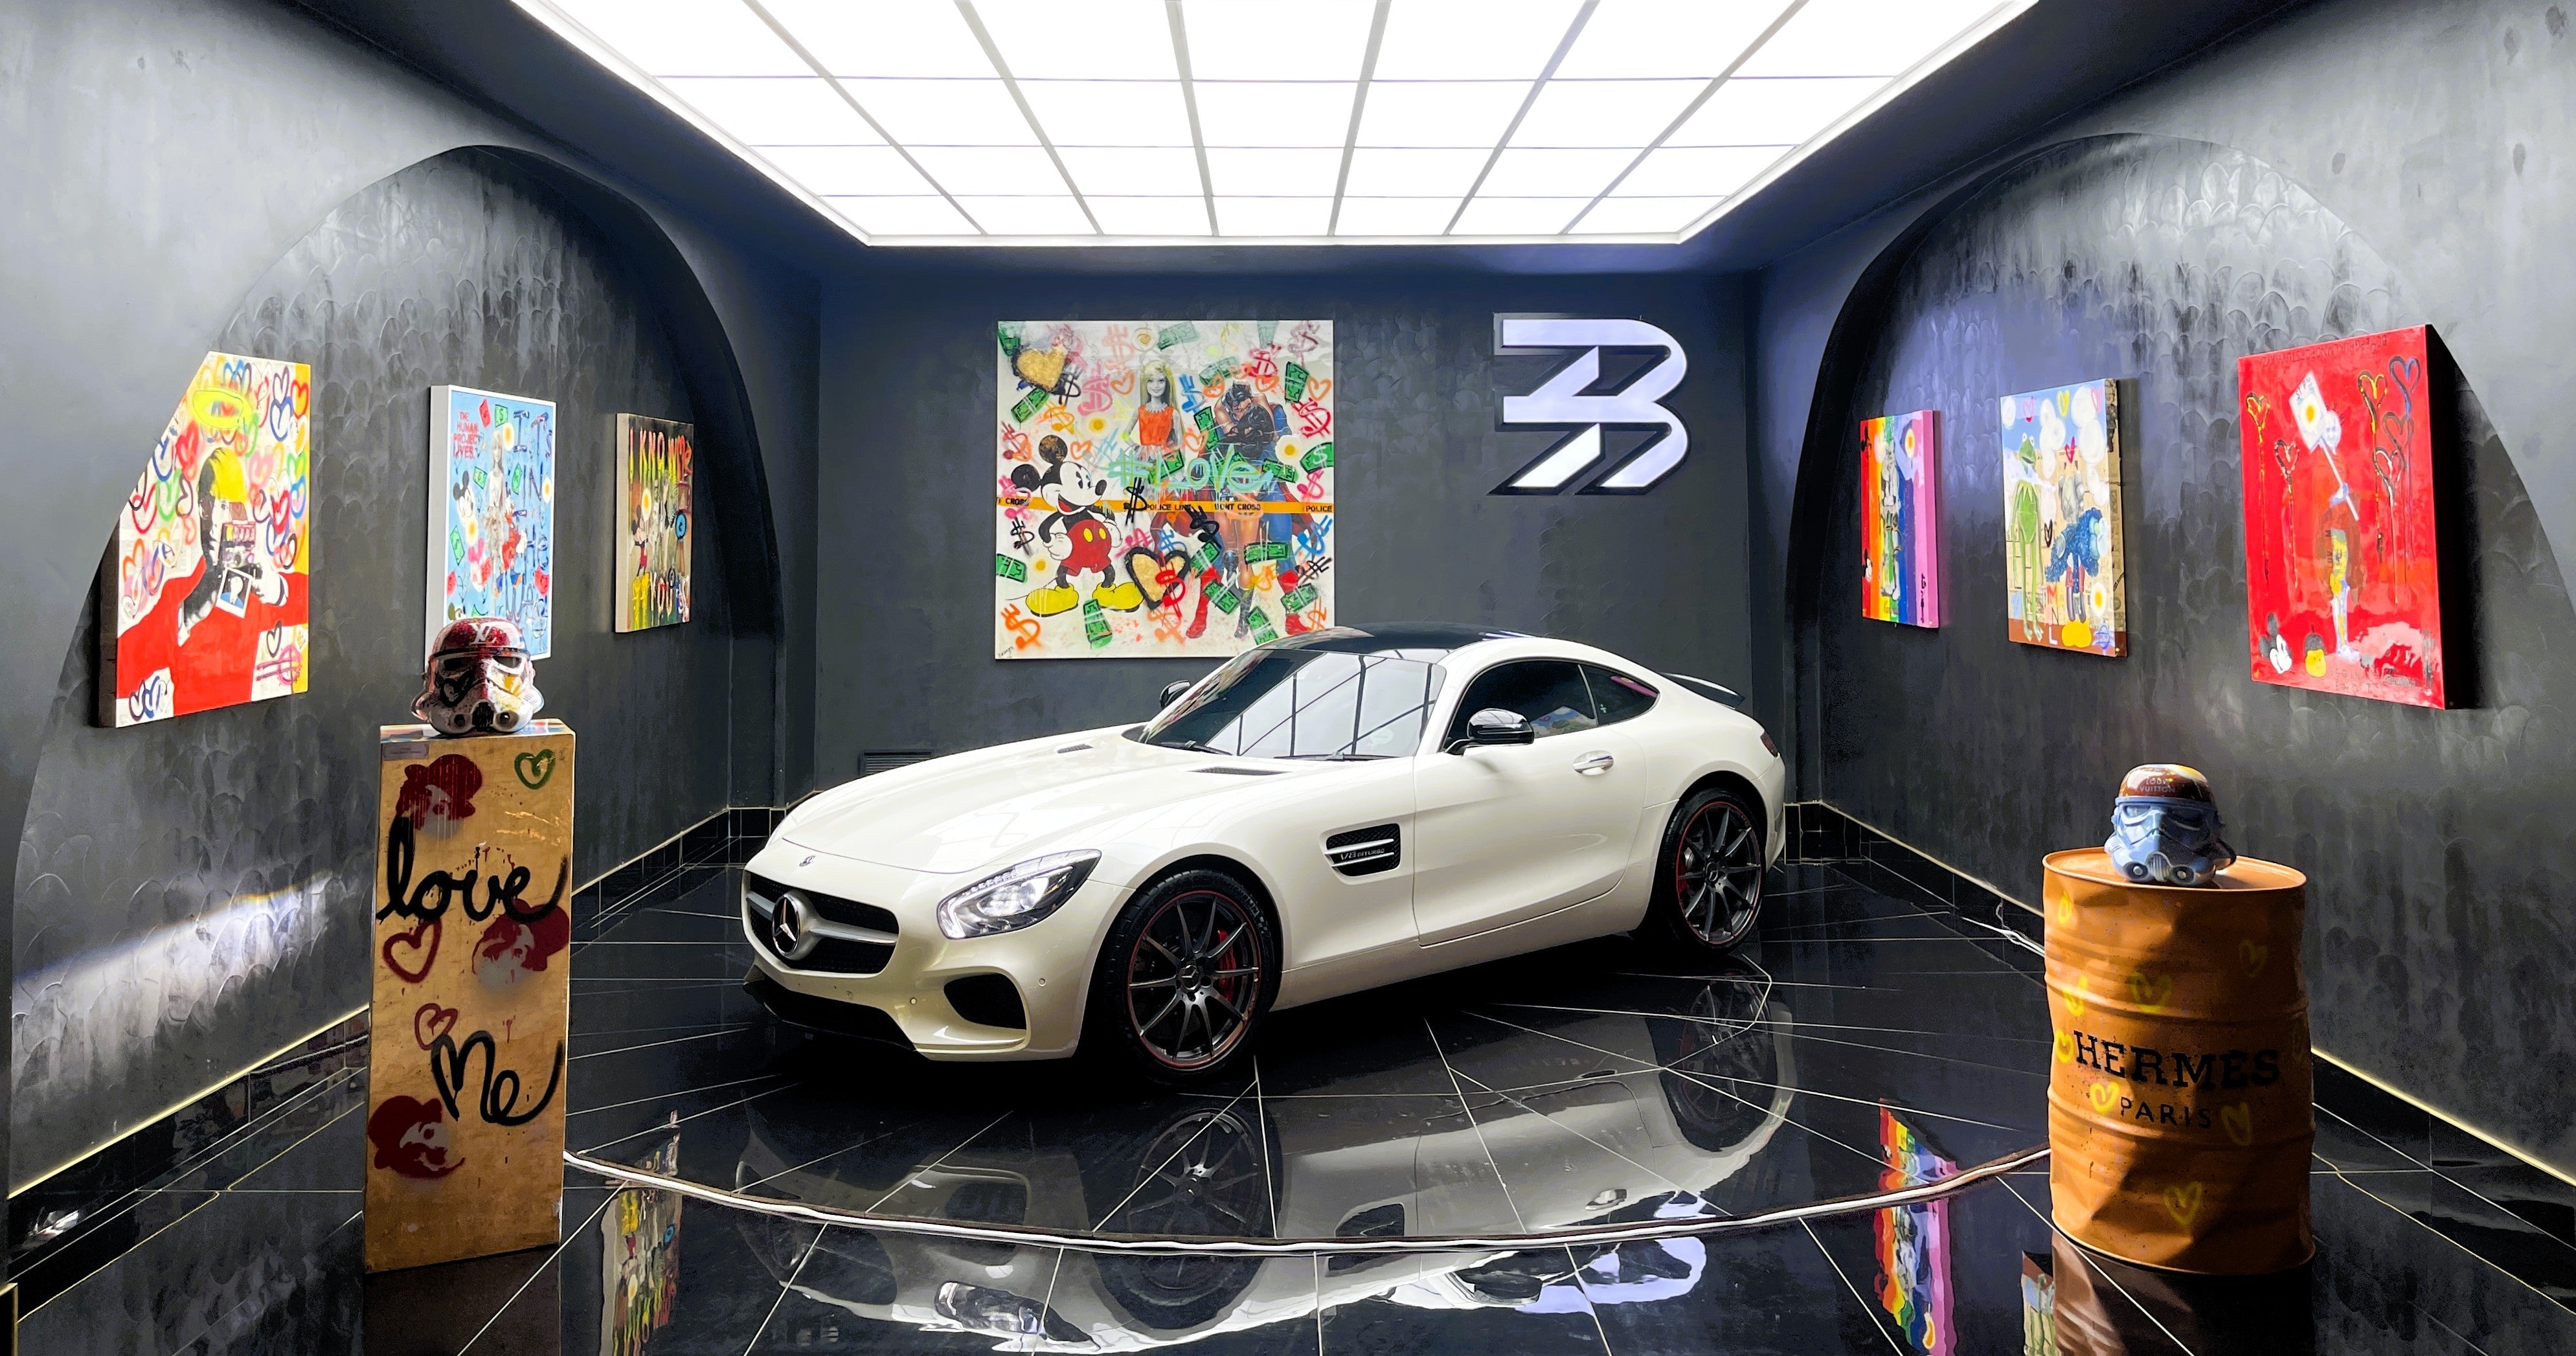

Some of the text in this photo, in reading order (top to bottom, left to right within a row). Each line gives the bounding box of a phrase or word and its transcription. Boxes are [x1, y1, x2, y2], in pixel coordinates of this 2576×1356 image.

[2140, 785, 2175, 793] VUITTON
[1340, 848, 1385, 860] V8 BITURBO
[376, 815, 570, 923] love
[2120, 1097, 2212, 1128] PARIS
